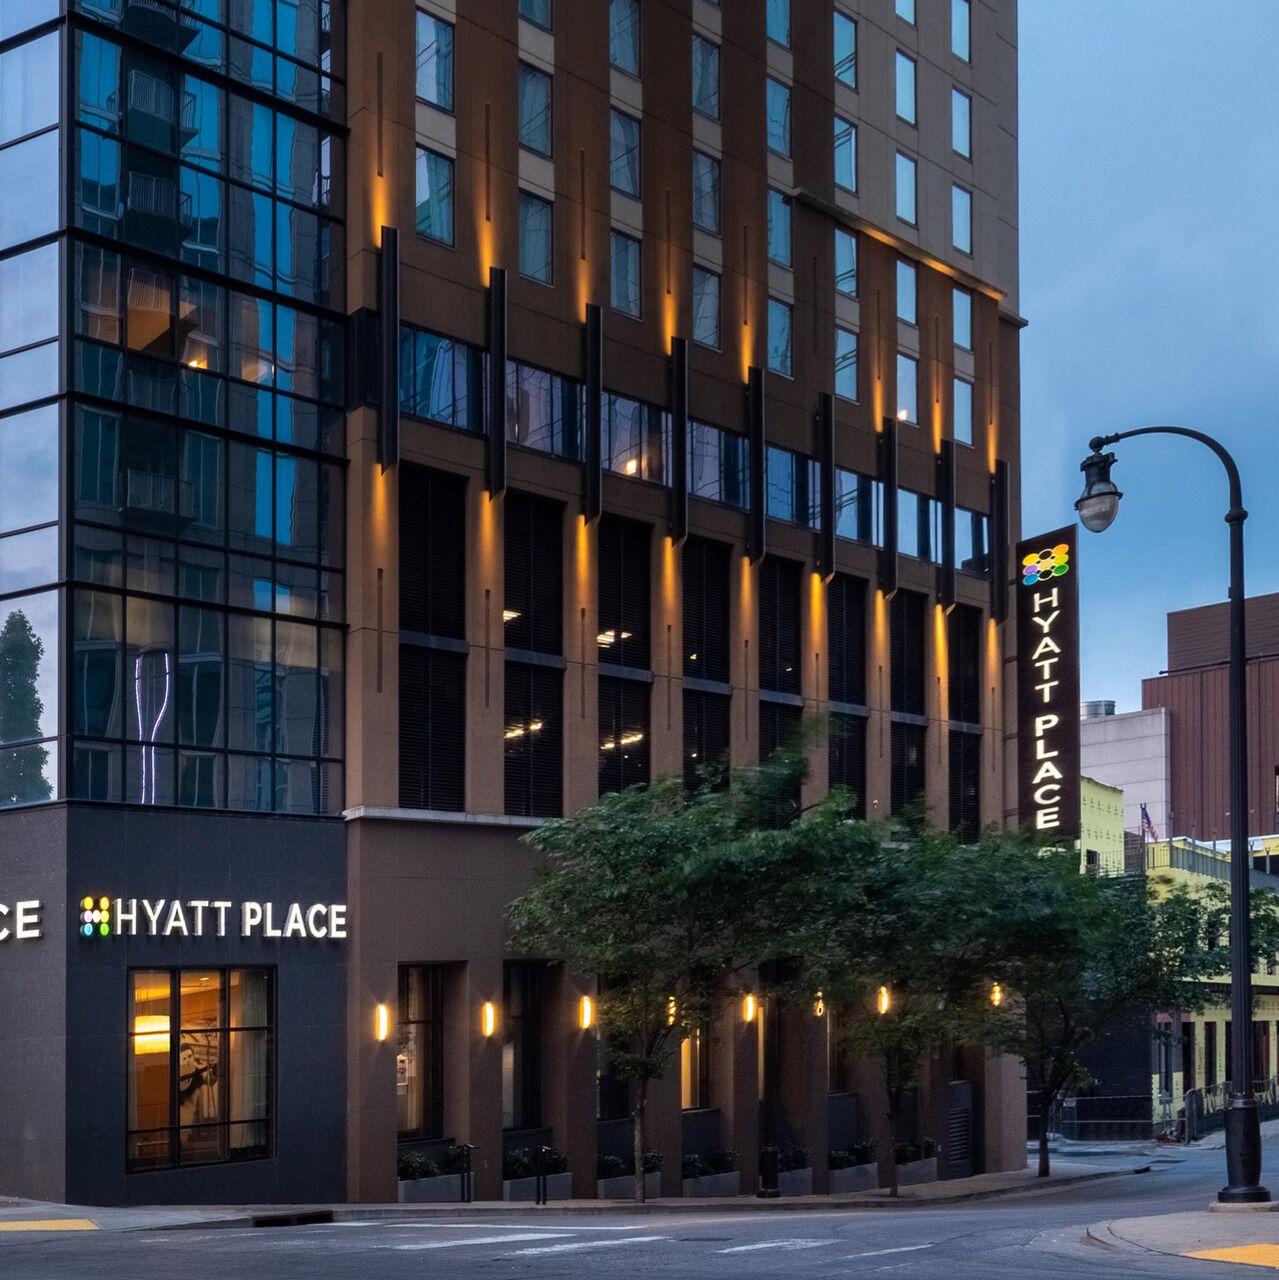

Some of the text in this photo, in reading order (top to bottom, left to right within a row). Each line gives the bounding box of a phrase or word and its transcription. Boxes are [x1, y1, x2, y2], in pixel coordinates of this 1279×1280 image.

[1031, 587, 1064, 830] HYATT PLACE
[114, 898, 347, 938] HYATT PLACE
